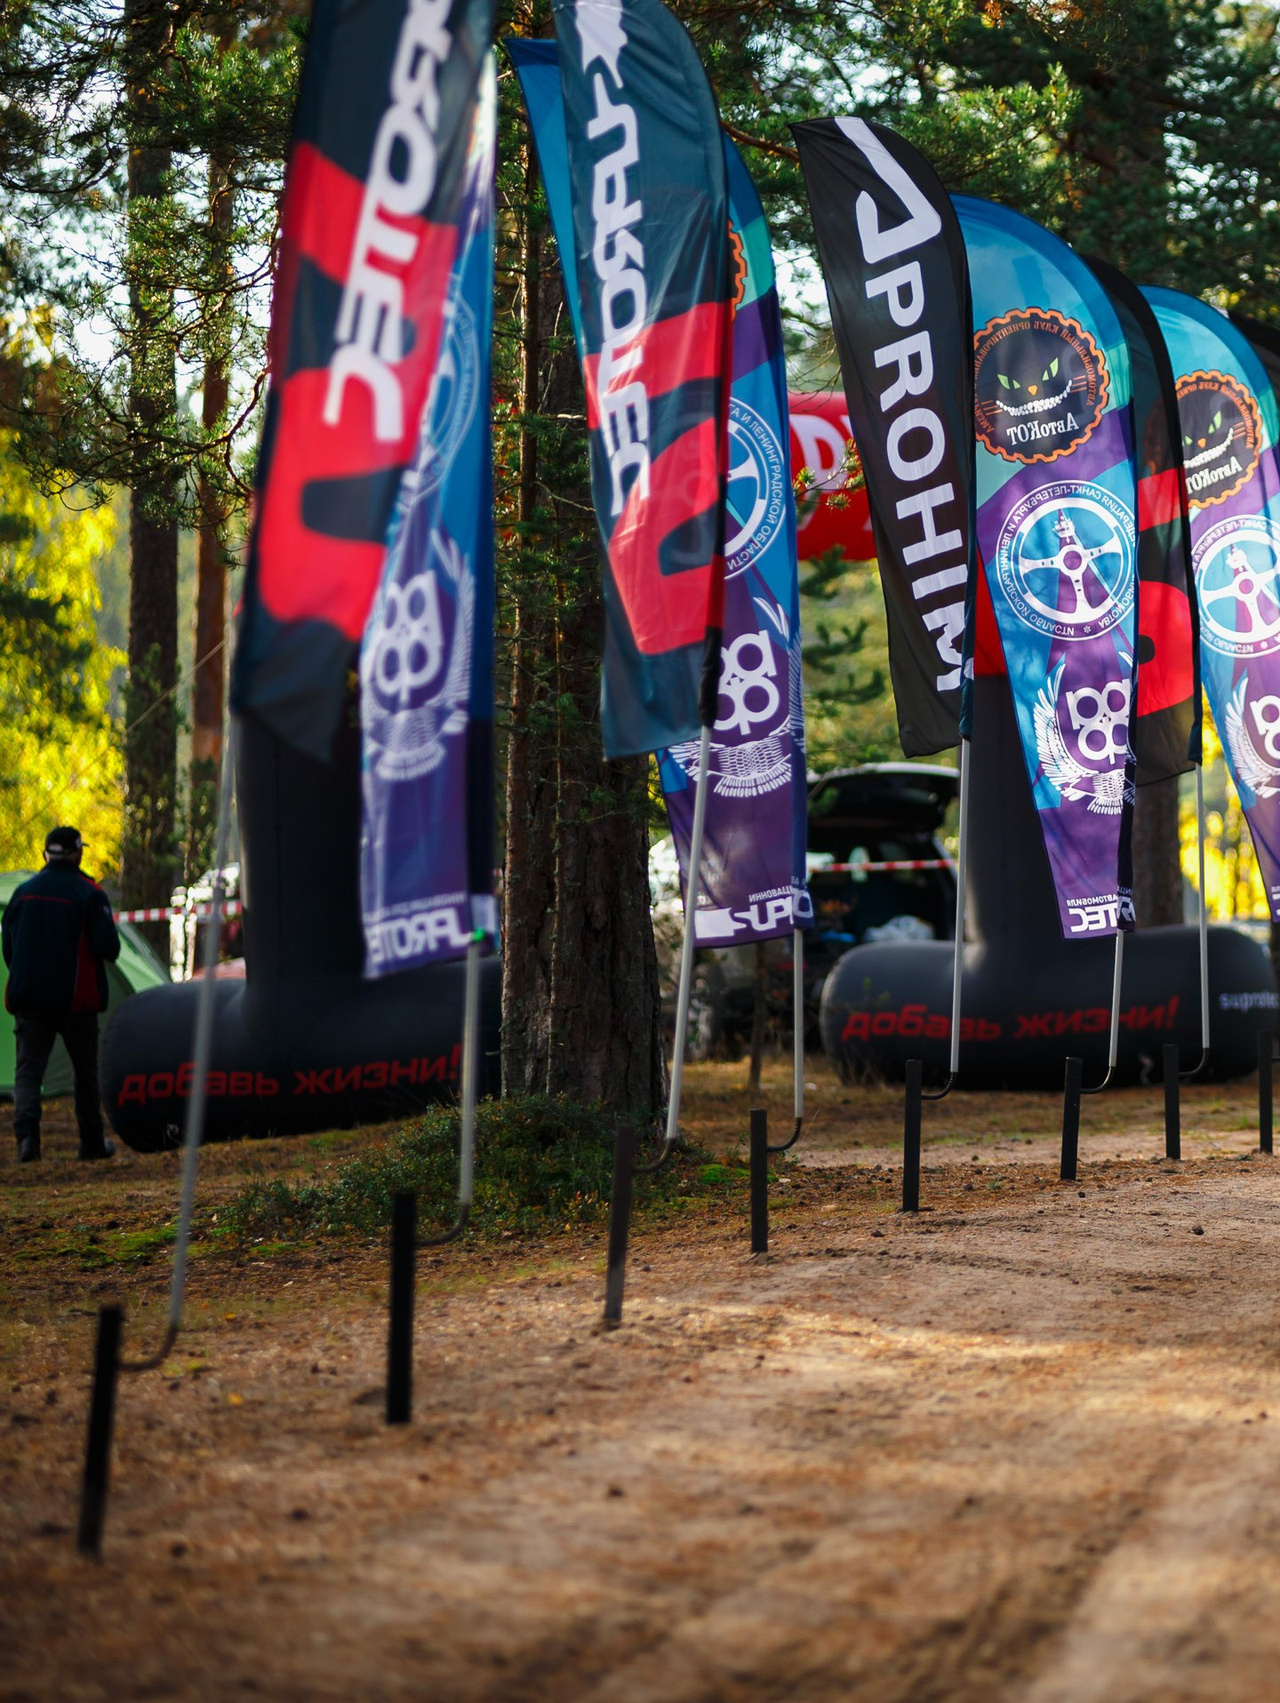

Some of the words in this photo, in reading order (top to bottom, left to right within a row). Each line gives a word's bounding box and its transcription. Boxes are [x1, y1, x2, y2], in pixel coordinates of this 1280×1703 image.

[748, 420, 785, 525] ЛЕНИНГРАДСКОЙ
[841, 1003, 1001, 1043] добавь
[1014, 995, 1179, 1039] жизни!
[118, 1061, 280, 1107] добавь
[293, 1044, 462, 1096] жизни!
